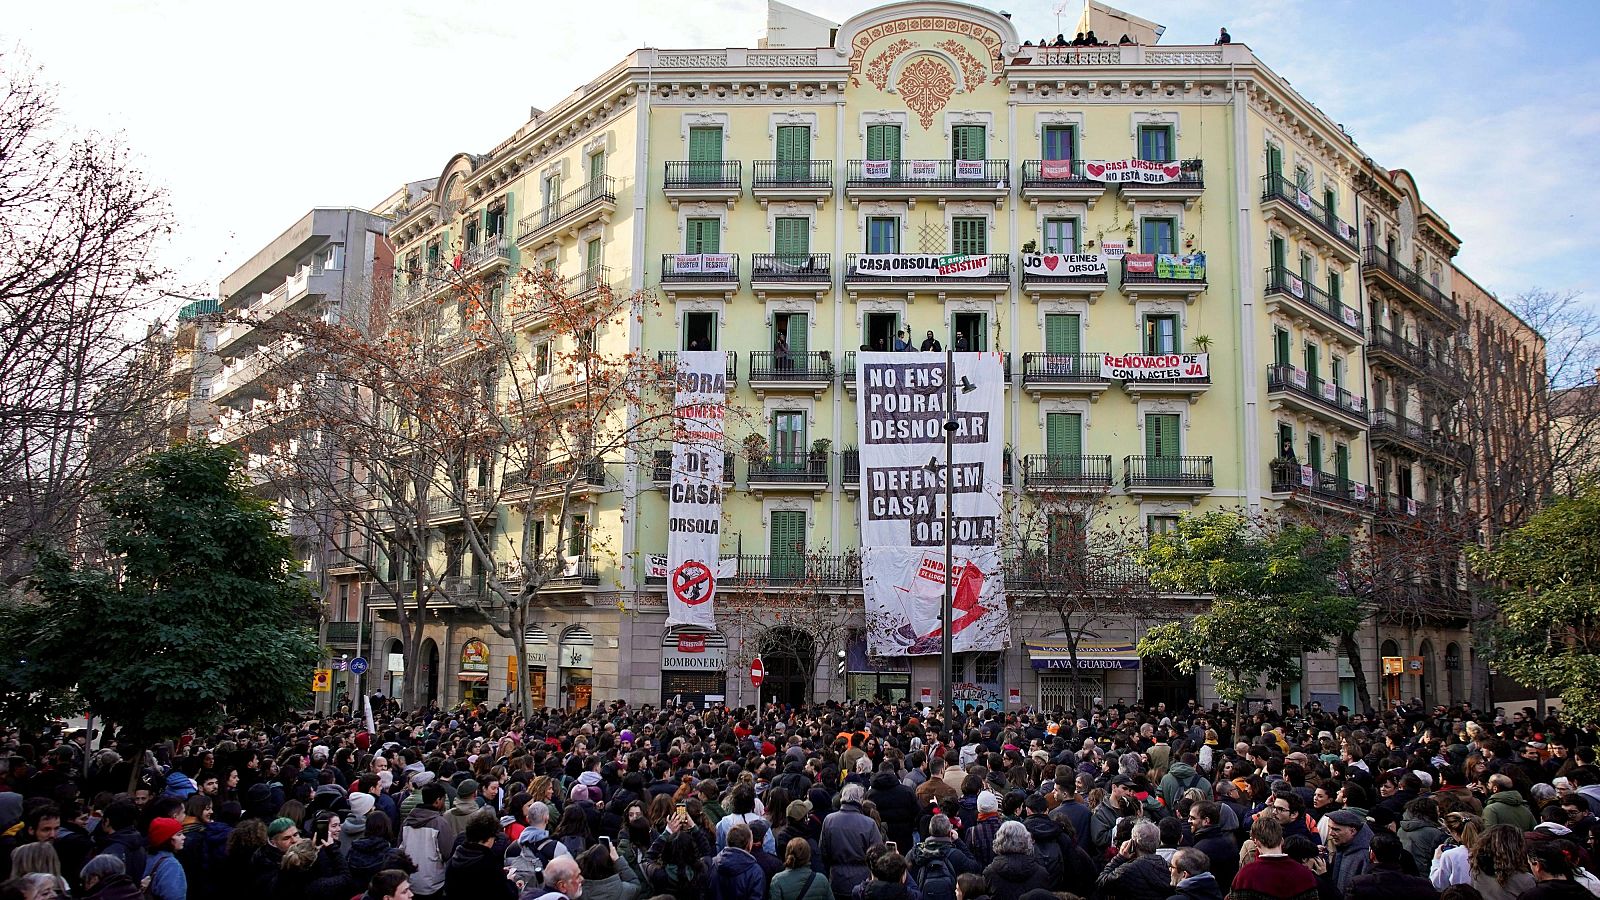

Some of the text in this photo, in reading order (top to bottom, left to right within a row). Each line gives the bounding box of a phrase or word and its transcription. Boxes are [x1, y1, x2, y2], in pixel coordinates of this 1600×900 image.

[1106, 161, 1128, 170] CASA
[1106, 170, 1164, 182] NO ESTÀ SOLA
[860, 257, 939, 270] CASA ORSOLA
[1024, 256, 1041, 268] JO
[1063, 255, 1097, 263] VEINES
[939, 257, 987, 275] RESISTINT
[1069, 263, 1106, 273] ORSOLA
[1113, 369, 1180, 379] CONACTES
[1185, 364, 1203, 375] JA
[869, 368, 943, 387] NO ENS
[871, 417, 983, 440] DESNOAR
[687, 452, 709, 472] DE
[872, 467, 980, 491] DEFENSEM
[672, 483, 721, 504] CASA
[874, 496, 929, 516] CASA
[670, 518, 718, 534] ORSOLA
[664, 658, 724, 668] BOMBONERIA
[1048, 660, 1122, 669] LA VAGUARDIA
